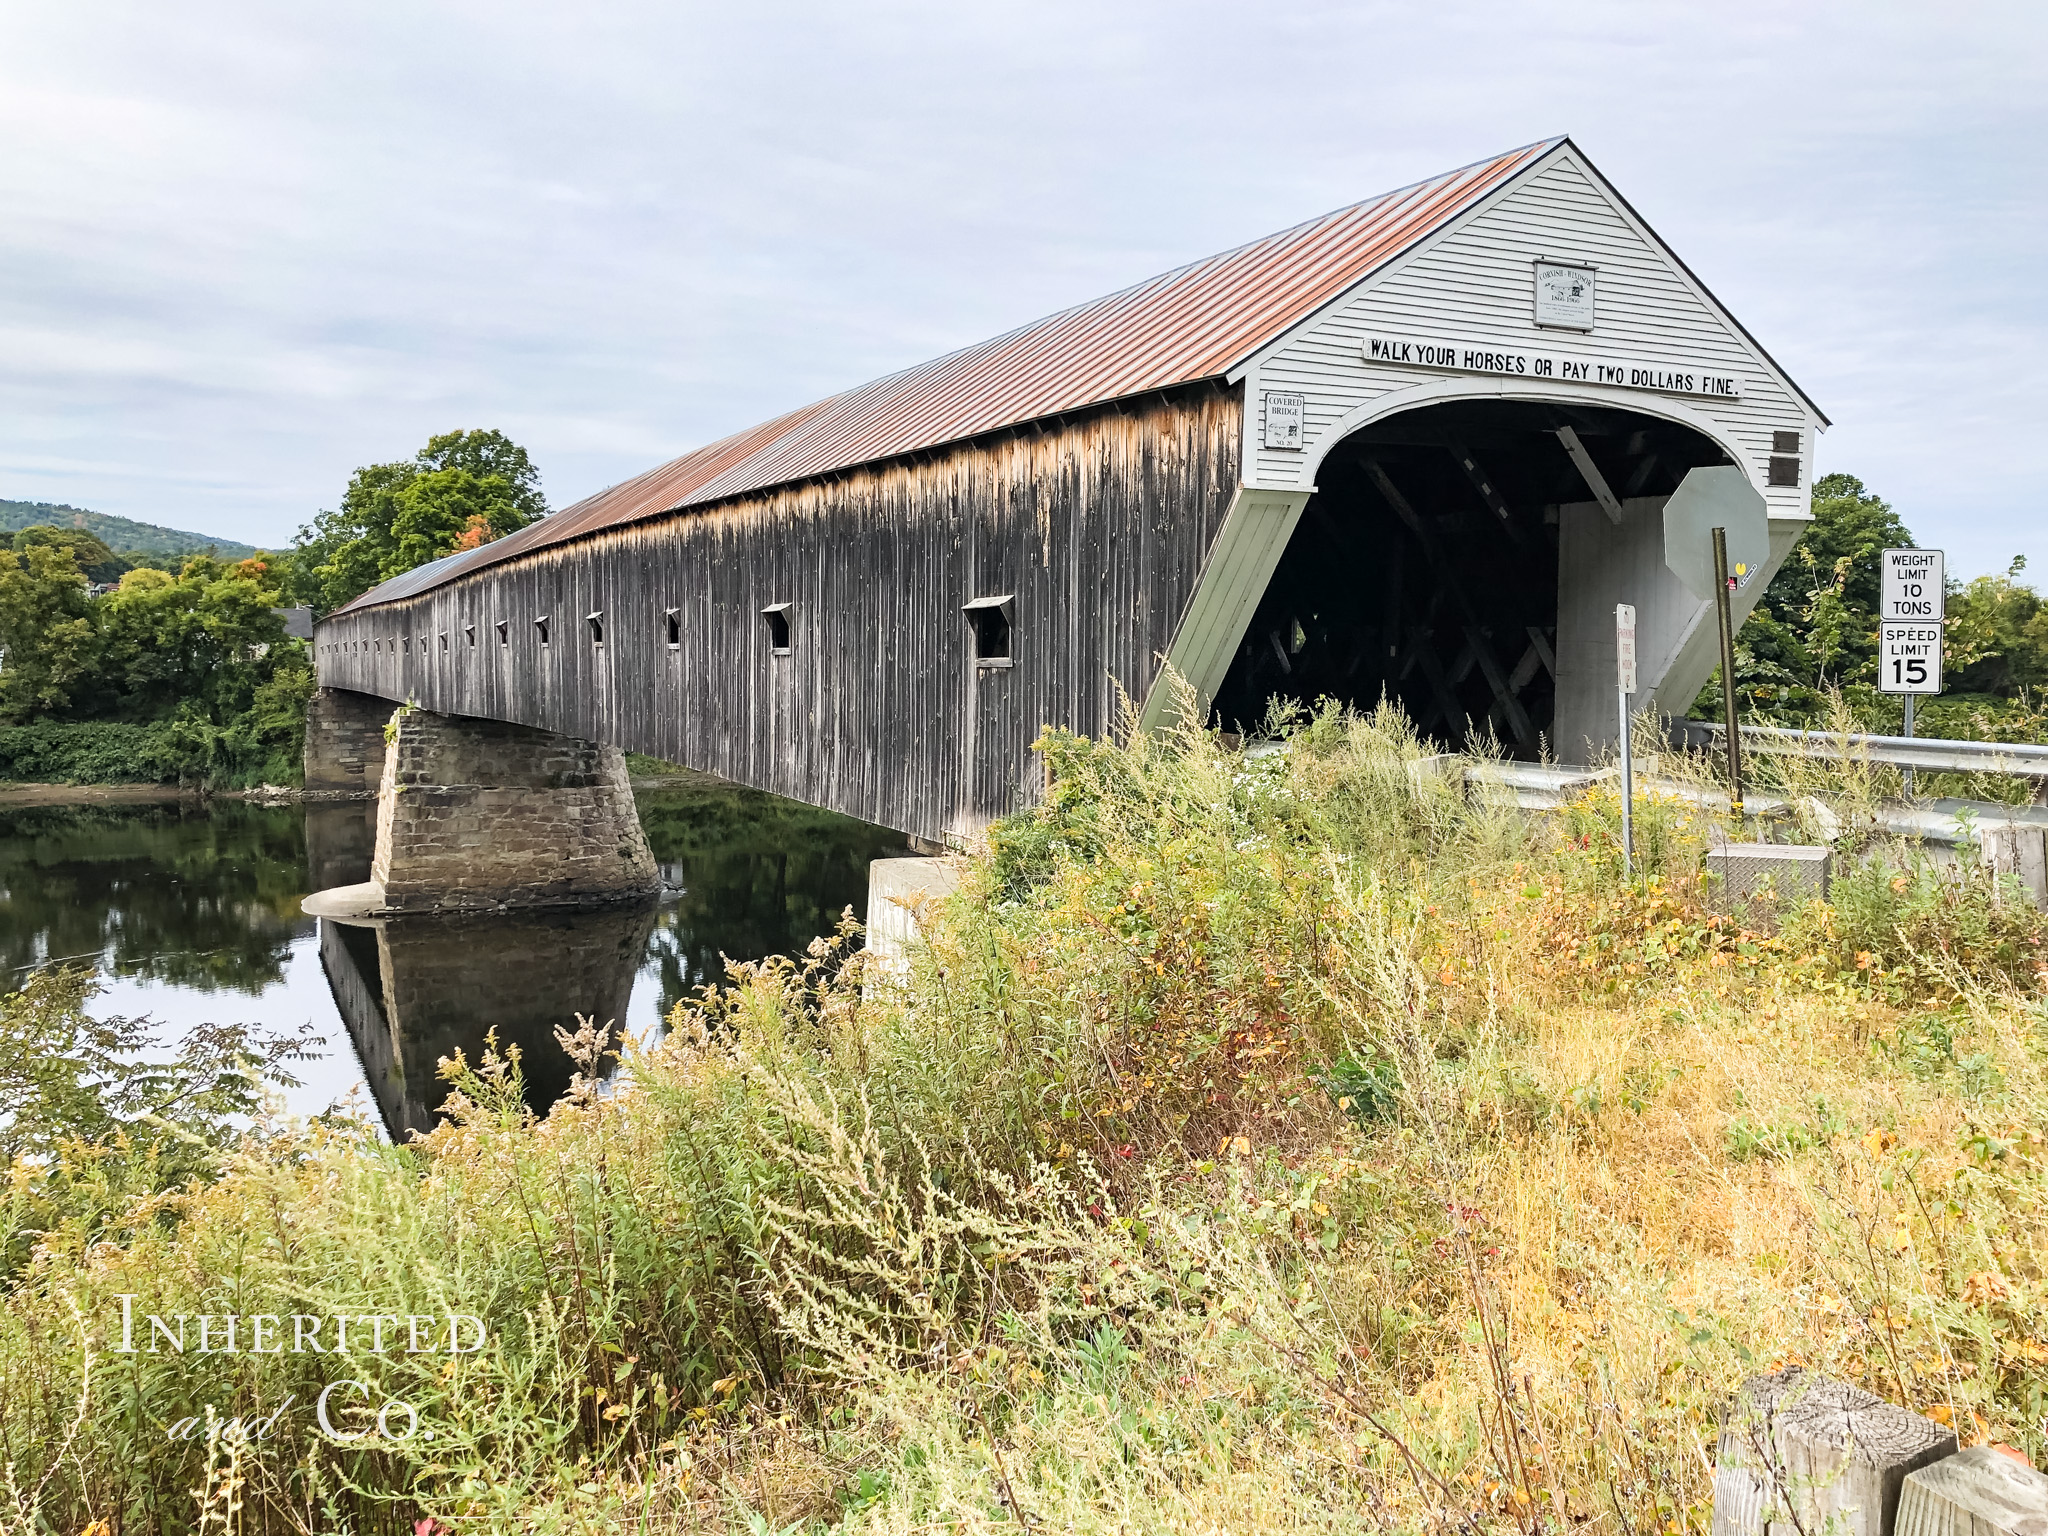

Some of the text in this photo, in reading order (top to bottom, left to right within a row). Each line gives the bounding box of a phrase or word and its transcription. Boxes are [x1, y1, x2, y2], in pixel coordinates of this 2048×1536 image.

[1539, 270, 1564, 280] CORNISH
[1568, 271, 1592, 287] WINDSOR
[1371, 340, 1739, 395] WALK YOUR HORSES OR PAY TWO DOLLARS FINE.
[1268, 396, 1302, 407] COVERED
[1272, 407, 1299, 416] BRIDGE
[1892, 555, 1935, 566] WEIGHT
[1898, 569, 1928, 580] LIMIT
[1903, 584, 1922, 597] 10
[1893, 602, 1932, 615] TONS
[1886, 630, 1937, 641] SPEED
[1891, 645, 1930, 655] LIMIT
[1893, 659, 1927, 684] 15
